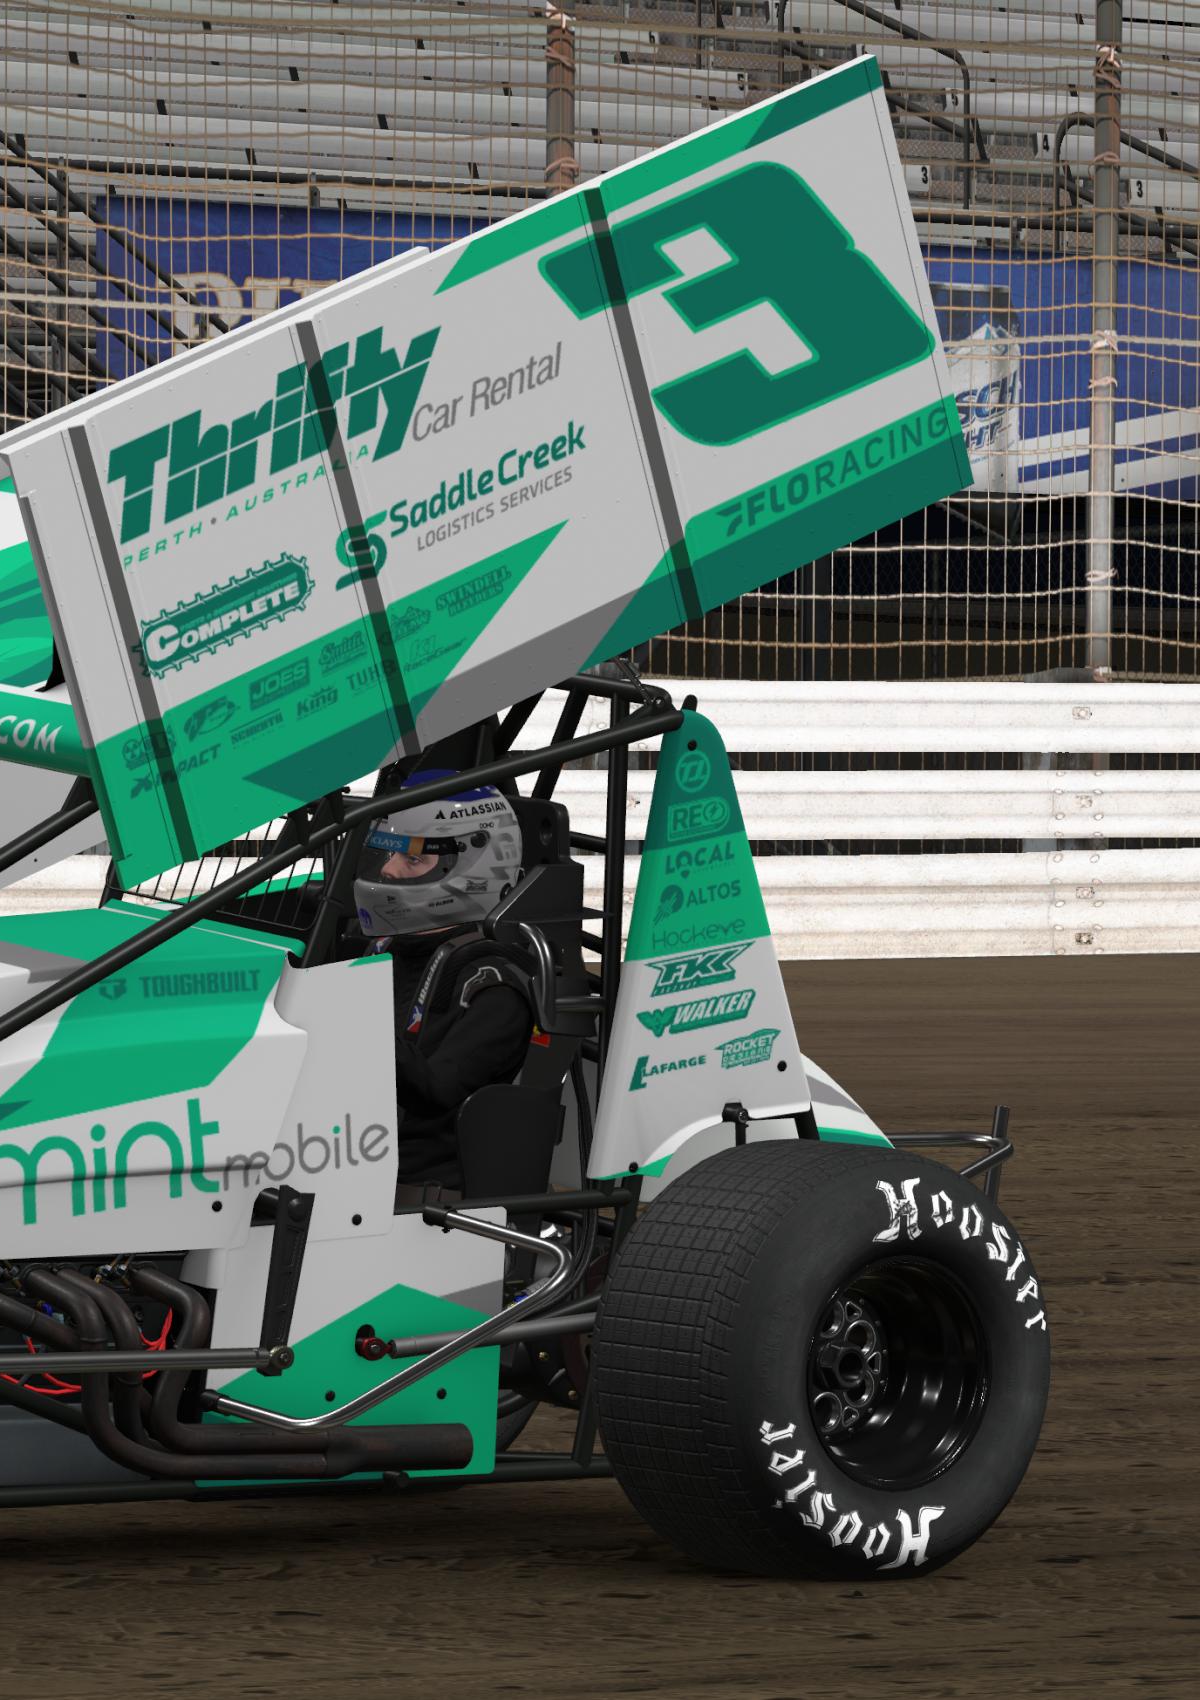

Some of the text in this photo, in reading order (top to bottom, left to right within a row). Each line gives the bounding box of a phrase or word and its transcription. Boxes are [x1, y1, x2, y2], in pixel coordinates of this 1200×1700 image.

[1041, 134, 1050, 152] 4
[920, 166, 929, 184] 3
[1135, 180, 1144, 199] 3
[538, 160, 936, 446] 3
[412, 341, 562, 442] Car Rental
[106, 325, 442, 545] Thrifty
[747, 406, 949, 528] FLORACING
[122, 445, 369, 571] PERTH AUSTRALIA
[417, 465, 573, 551] LOGISTICS SERVICES
[145, 581, 300, 663] COMPLETE
[252, 661, 307, 700] JOES
[449, 802, 507, 820] ATLASSIAN
[665, 841, 735, 877] LOCAL
[686, 880, 742, 908] ALTOS
[139, 969, 261, 999] TOUGHBUILT
[673, 989, 756, 1025] WALKER
[724, 1034, 774, 1055] ROCKET
[223, 1113, 390, 1192] mobile
[872, 1176, 1047, 1331] Hoosier
[760, 1420, 946, 1571] Hoosier
